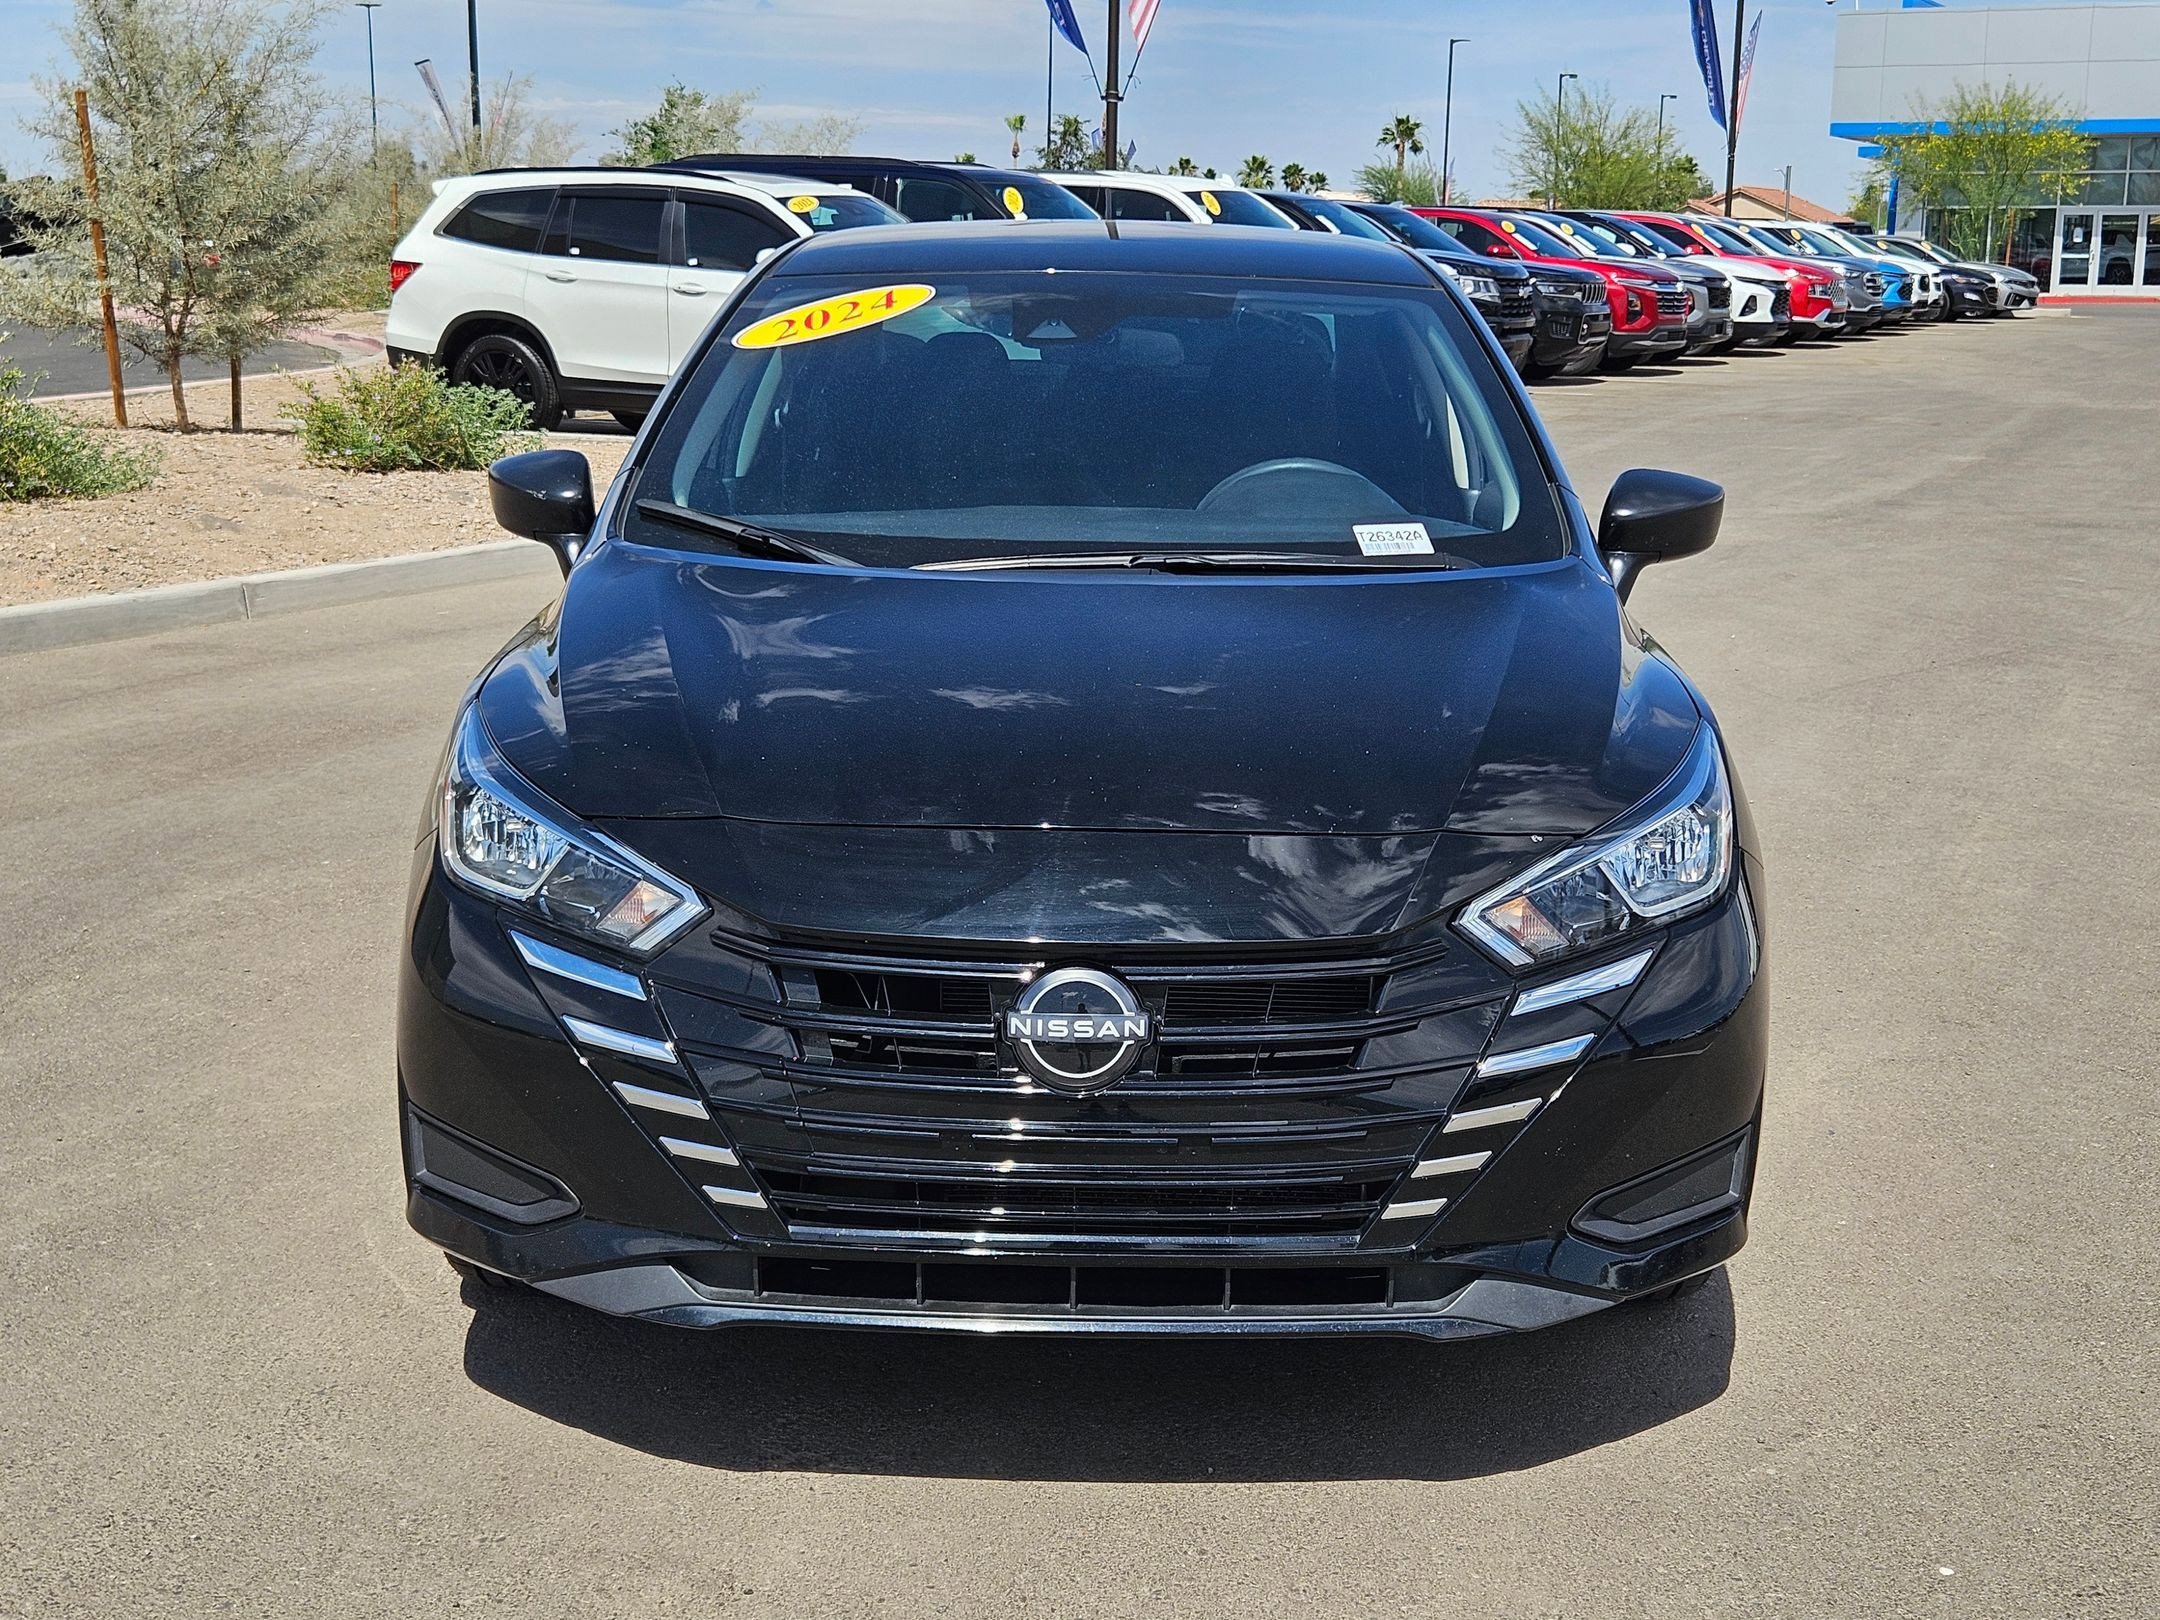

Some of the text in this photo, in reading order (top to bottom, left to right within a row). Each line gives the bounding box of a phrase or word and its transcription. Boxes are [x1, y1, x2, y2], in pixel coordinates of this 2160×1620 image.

[1701, 30, 1715, 107] CHEVROLET
[772, 290, 898, 342] 2024
[1356, 530, 1424, 542] T26342A
[1010, 1017, 1145, 1038] NISSAN
